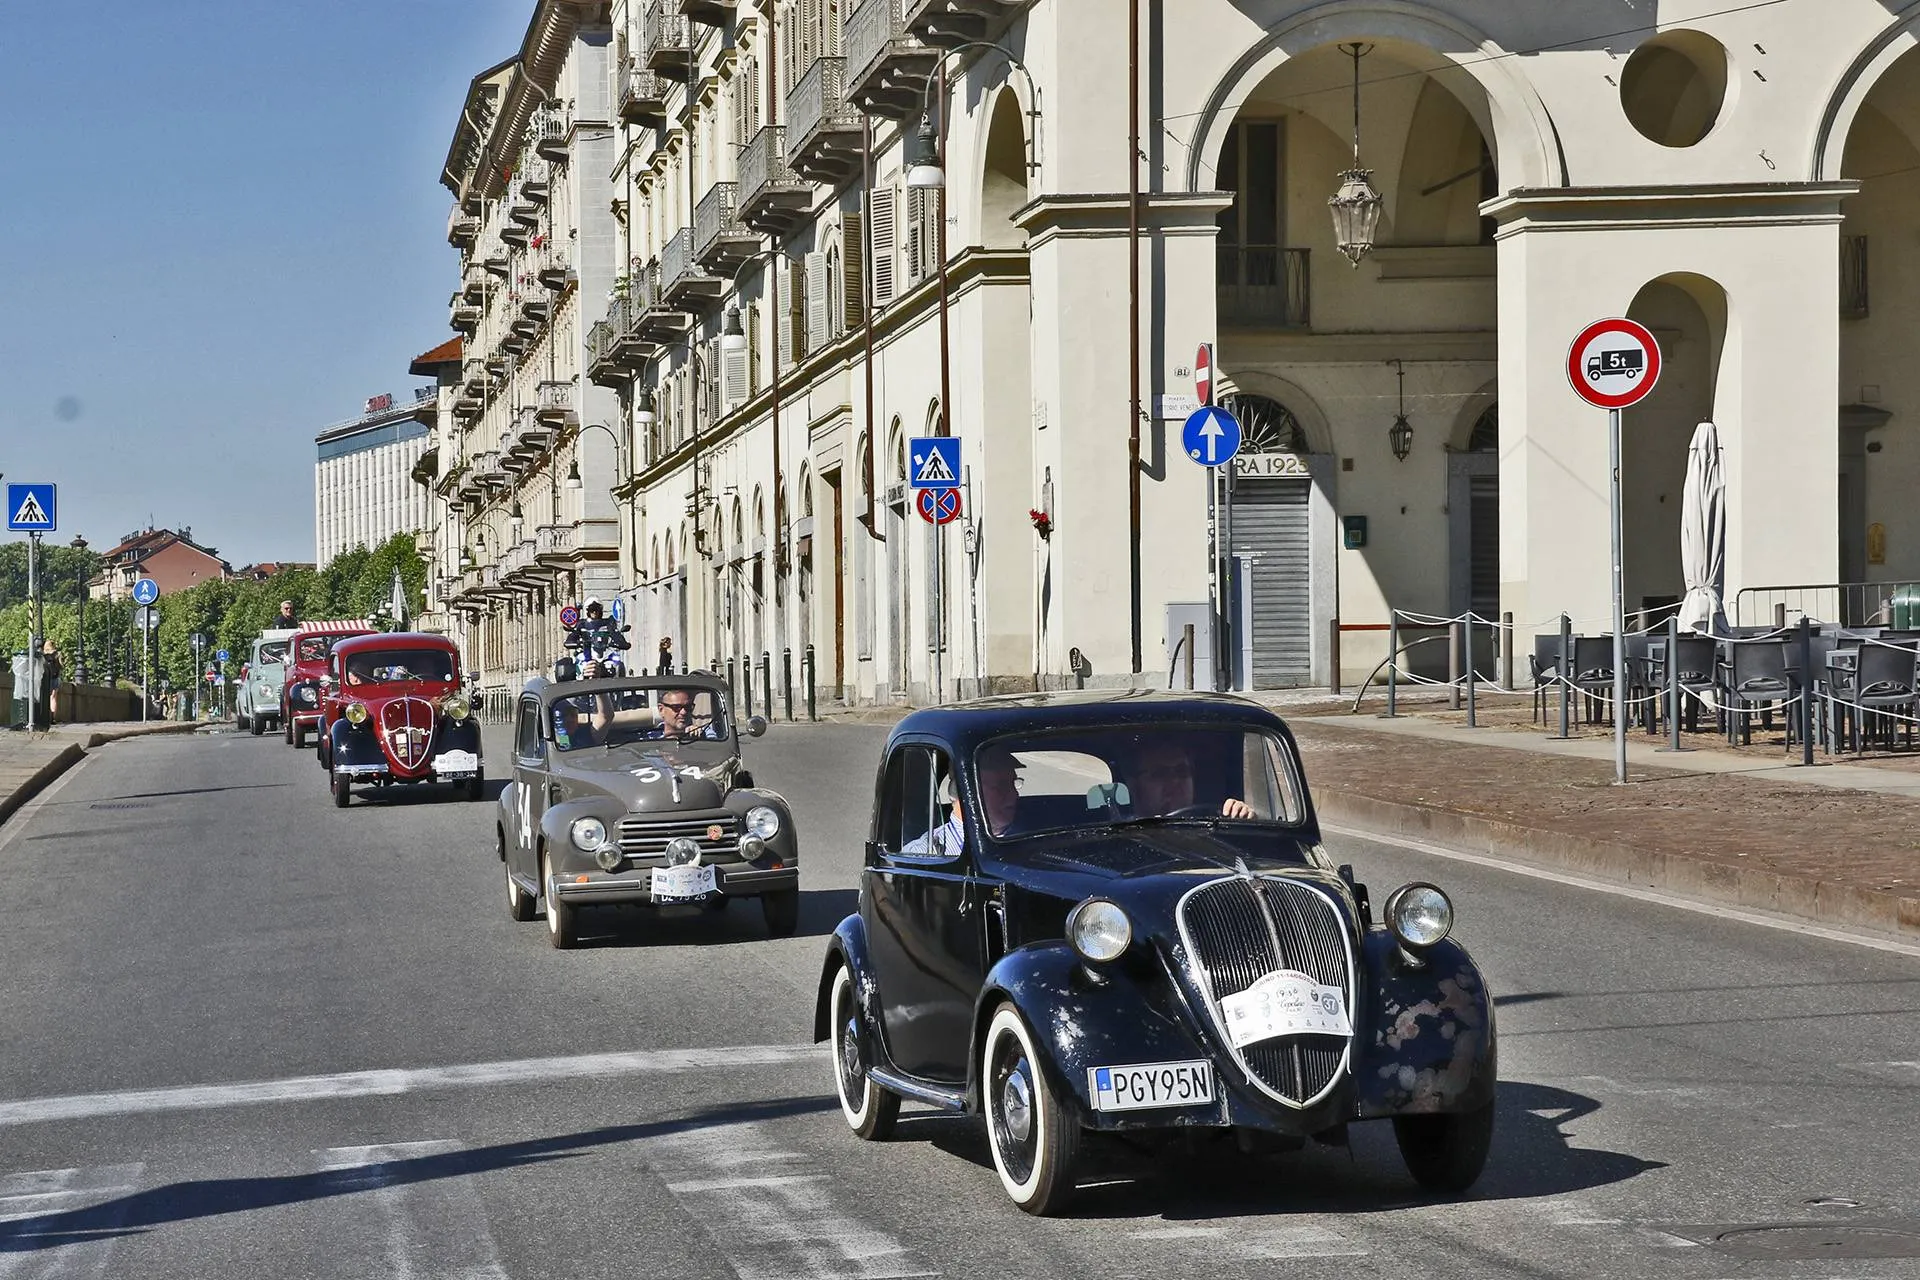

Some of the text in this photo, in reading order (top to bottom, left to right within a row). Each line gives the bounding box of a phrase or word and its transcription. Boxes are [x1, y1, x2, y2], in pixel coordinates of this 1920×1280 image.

[1610, 353, 1626, 367] 5t
[1322, 997, 1336, 1011] 37
[1113, 1066, 1208, 1104] PGY95N
